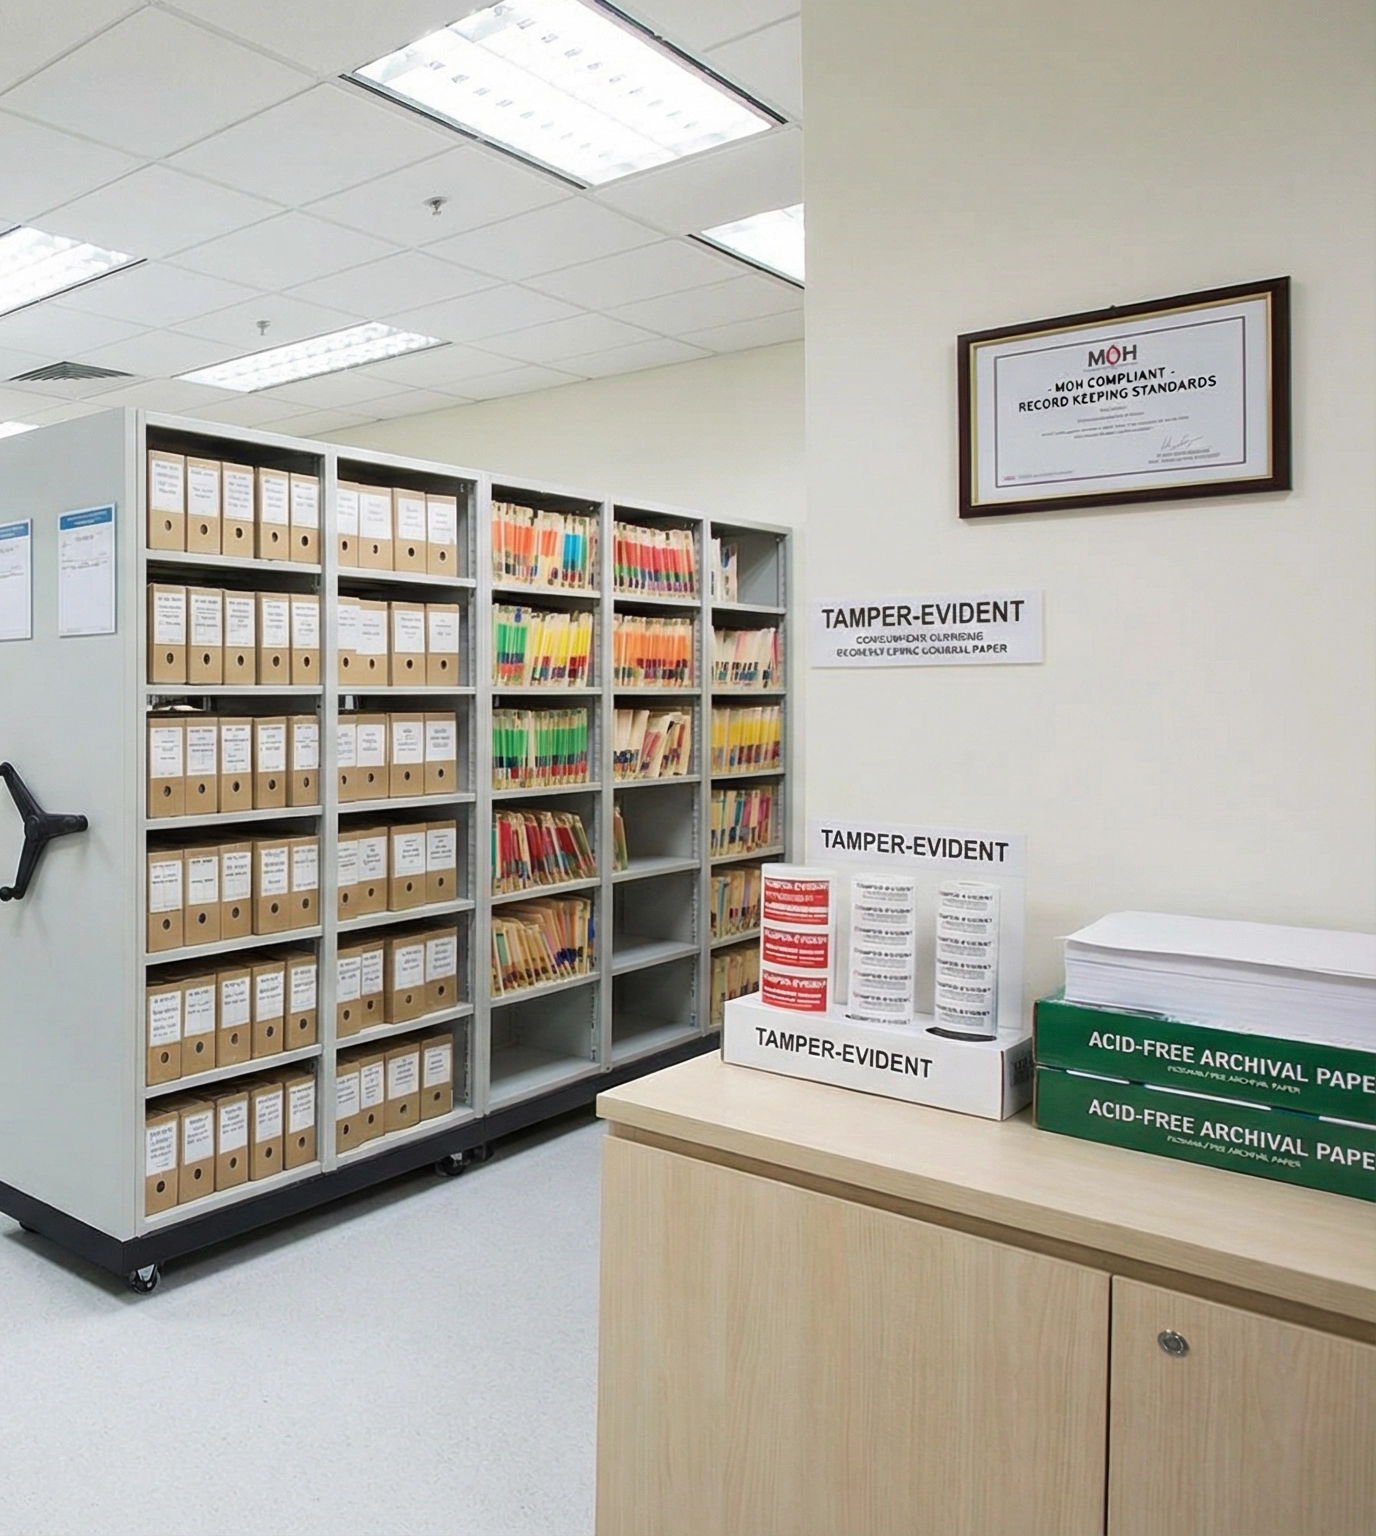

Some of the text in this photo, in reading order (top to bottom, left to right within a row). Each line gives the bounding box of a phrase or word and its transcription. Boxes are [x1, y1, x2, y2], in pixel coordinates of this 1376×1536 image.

[1088, 344, 1137, 367] MOH
[1019, 375, 1217, 412] RECORD KEEPING STANDARDS
[1055, 379, 1084, 393] MOH
[1087, 367, 1166, 389] COMPLIANT
[822, 600, 1025, 628] TAMPER-EVIDENT
[821, 829, 1009, 862] TAMPER-EVIDENT
[755, 1027, 933, 1078] TAMPER-EVIDENT
[1088, 1031, 1195, 1063] ACID-FREE
[1200, 1049, 1309, 1083] ARCHIVAL
[1088, 1099, 1195, 1134] ACID-FREE
[1200, 1121, 1309, 1157] ARCHIVAL
